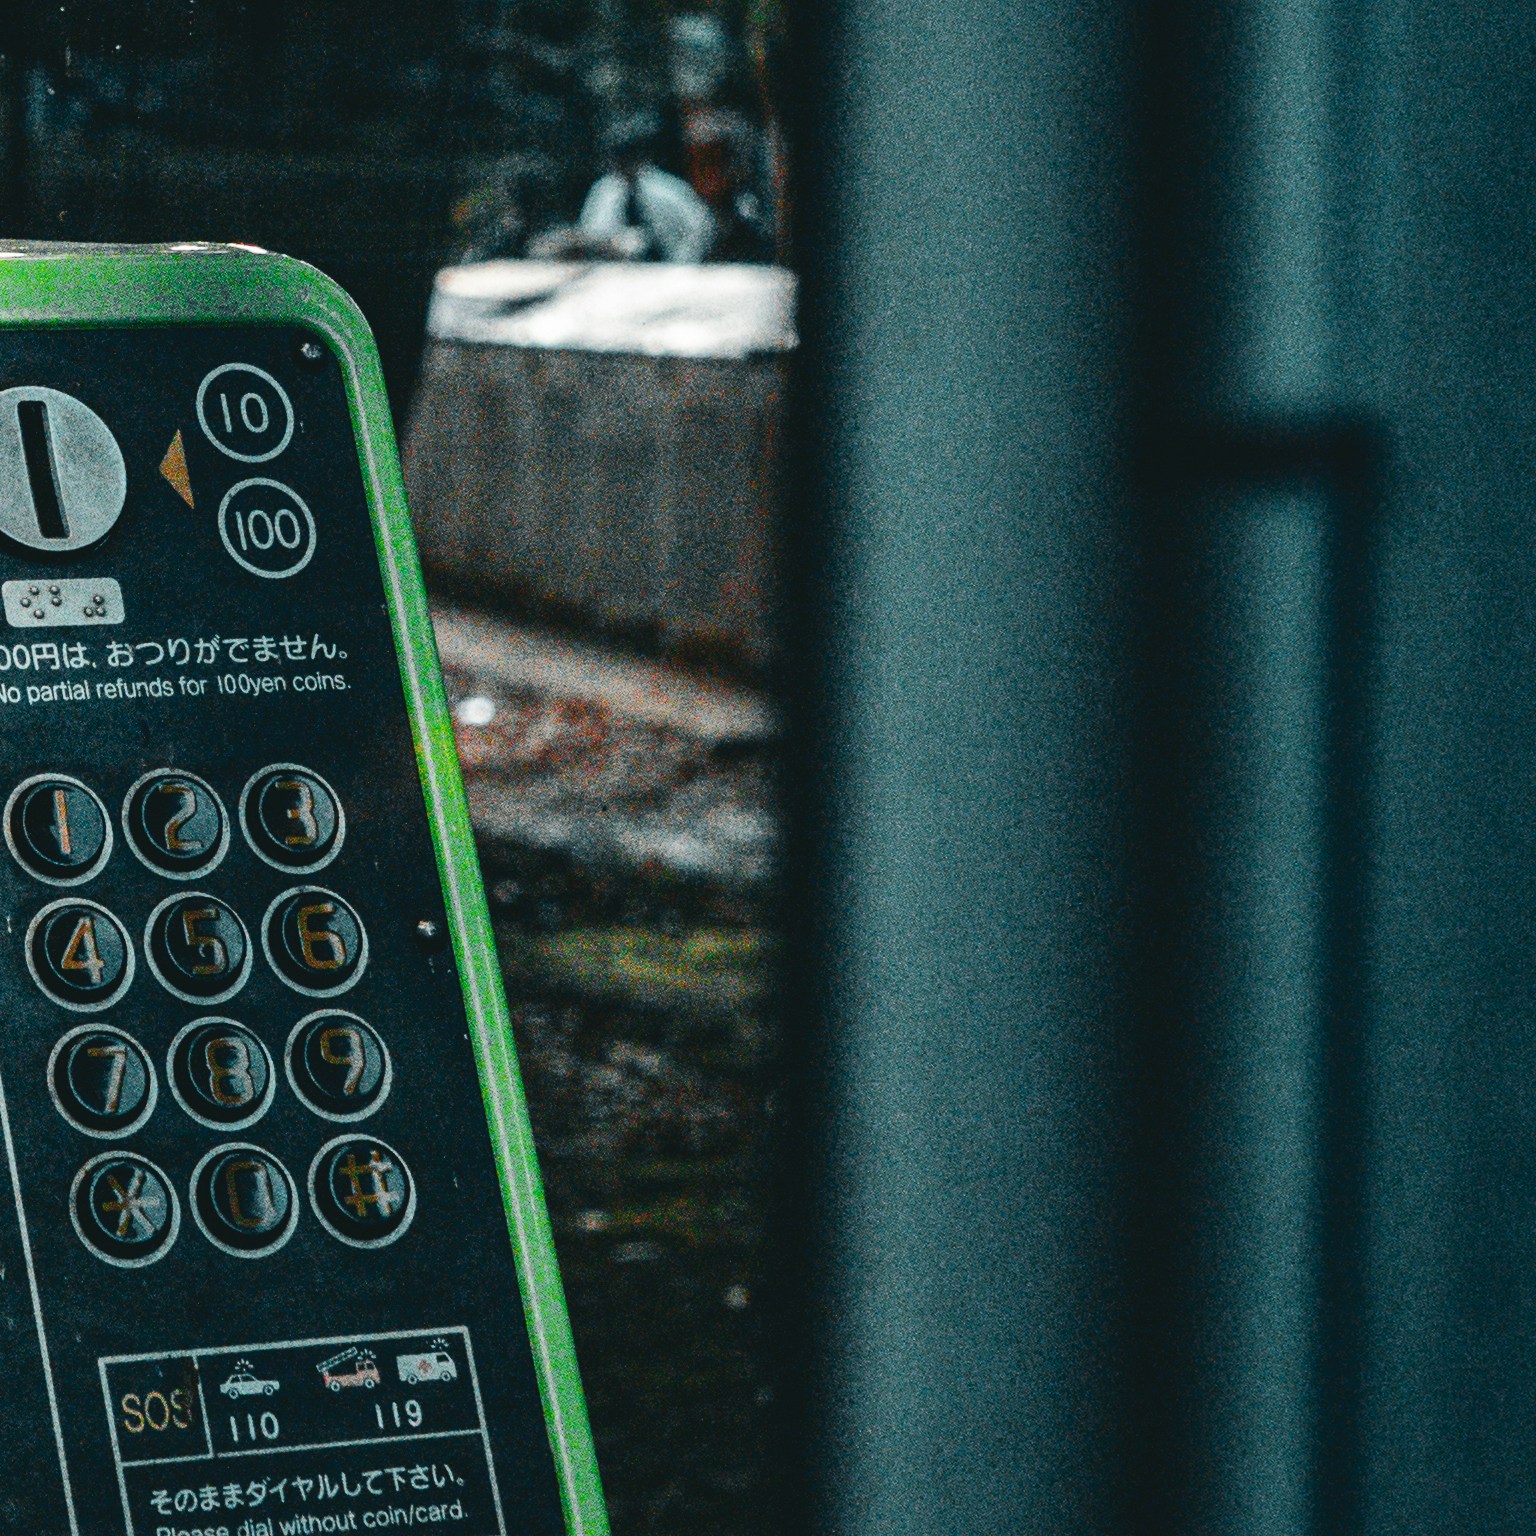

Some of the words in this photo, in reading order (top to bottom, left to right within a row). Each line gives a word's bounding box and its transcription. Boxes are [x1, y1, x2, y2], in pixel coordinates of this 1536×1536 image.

[220, 391, 269, 434] 10
[235, 509, 301, 552] 100
[28, 678, 90, 705] partial
[96, 675, 174, 699] refunds
[179, 675, 207, 696] for
[217, 672, 287, 700] 100yen
[292, 669, 351, 693] coins.
[50, 789, 71, 855] 1
[159, 782, 204, 850] 2
[275, 780, 319, 845] 3
[61, 915, 106, 984] 4
[182, 907, 227, 976] 5
[297, 902, 348, 971] 6
[87, 1045, 127, 1114] 7
[204, 1036, 255, 1106] 8
[320, 1026, 365, 1096] 9
[225, 1160, 279, 1230] 0
[121, 1387, 193, 1434] SOS
[229, 1411, 280, 1443] 110
[375, 1399, 424, 1430] 119
[150, 1464, 465, 1515] そのままダイヤルして下さい。
[279, 1511, 355, 1536] without
[364, 1500, 469, 1530] coin/card.
